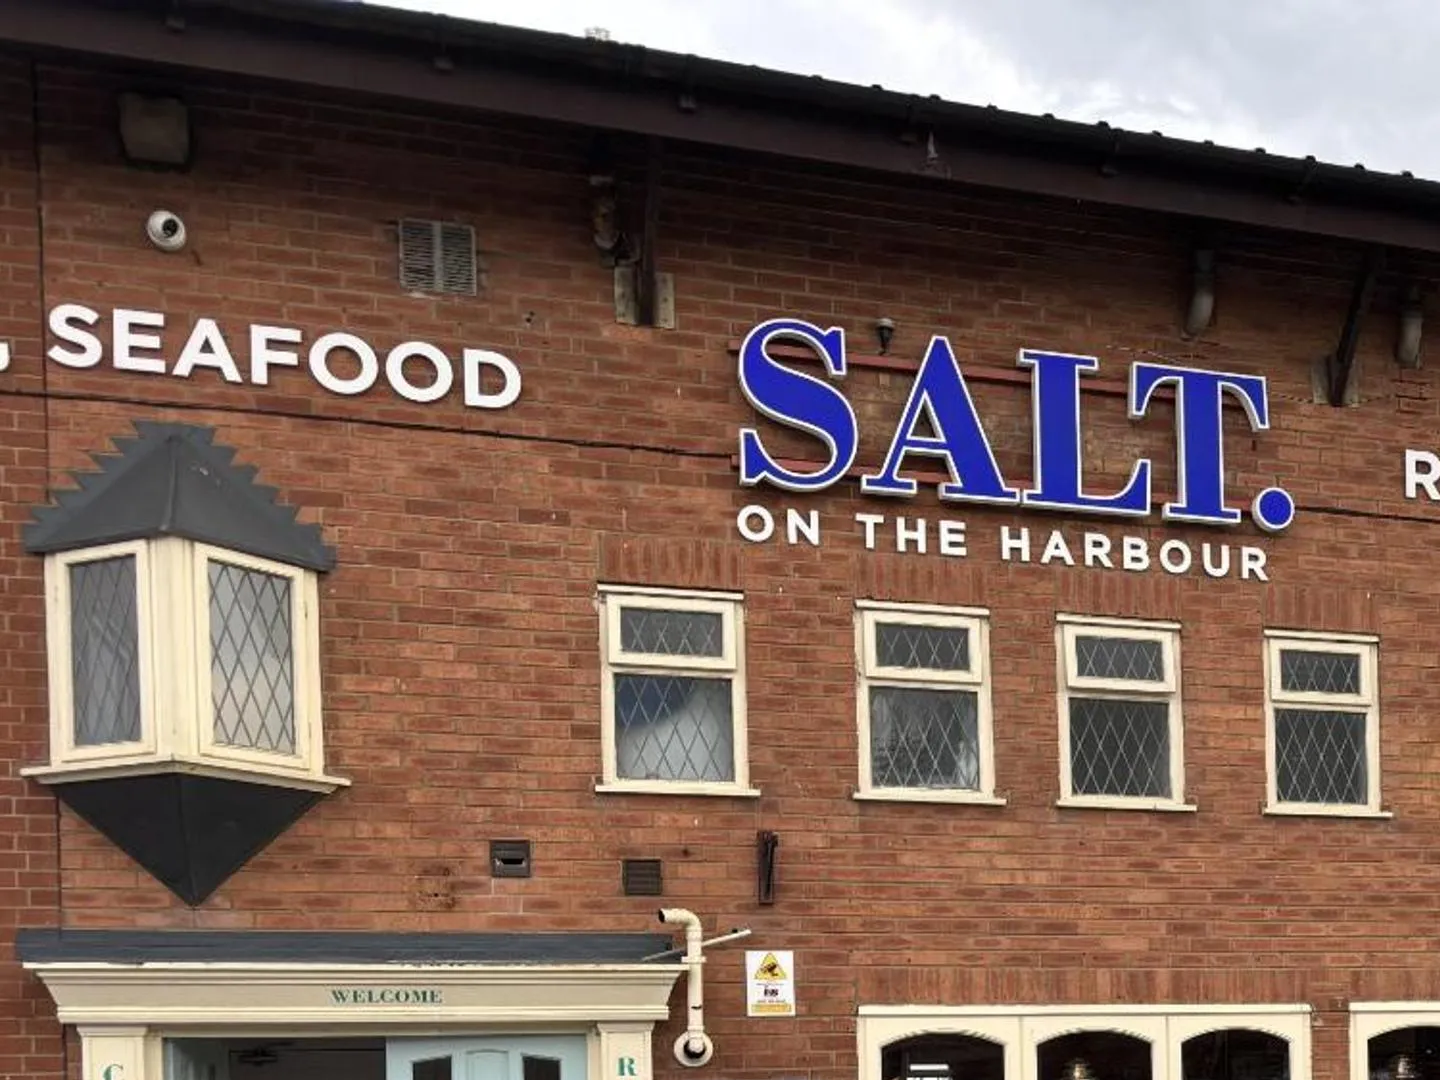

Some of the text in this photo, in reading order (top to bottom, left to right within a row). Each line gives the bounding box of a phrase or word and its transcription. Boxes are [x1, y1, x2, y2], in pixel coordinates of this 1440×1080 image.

[47, 303, 521, 409] SEAFOOD
[737, 317, 1295, 533] SALT.
[737, 504, 1269, 581] ON THE HARBOUR
[331, 989, 442, 1003] WELCOME
